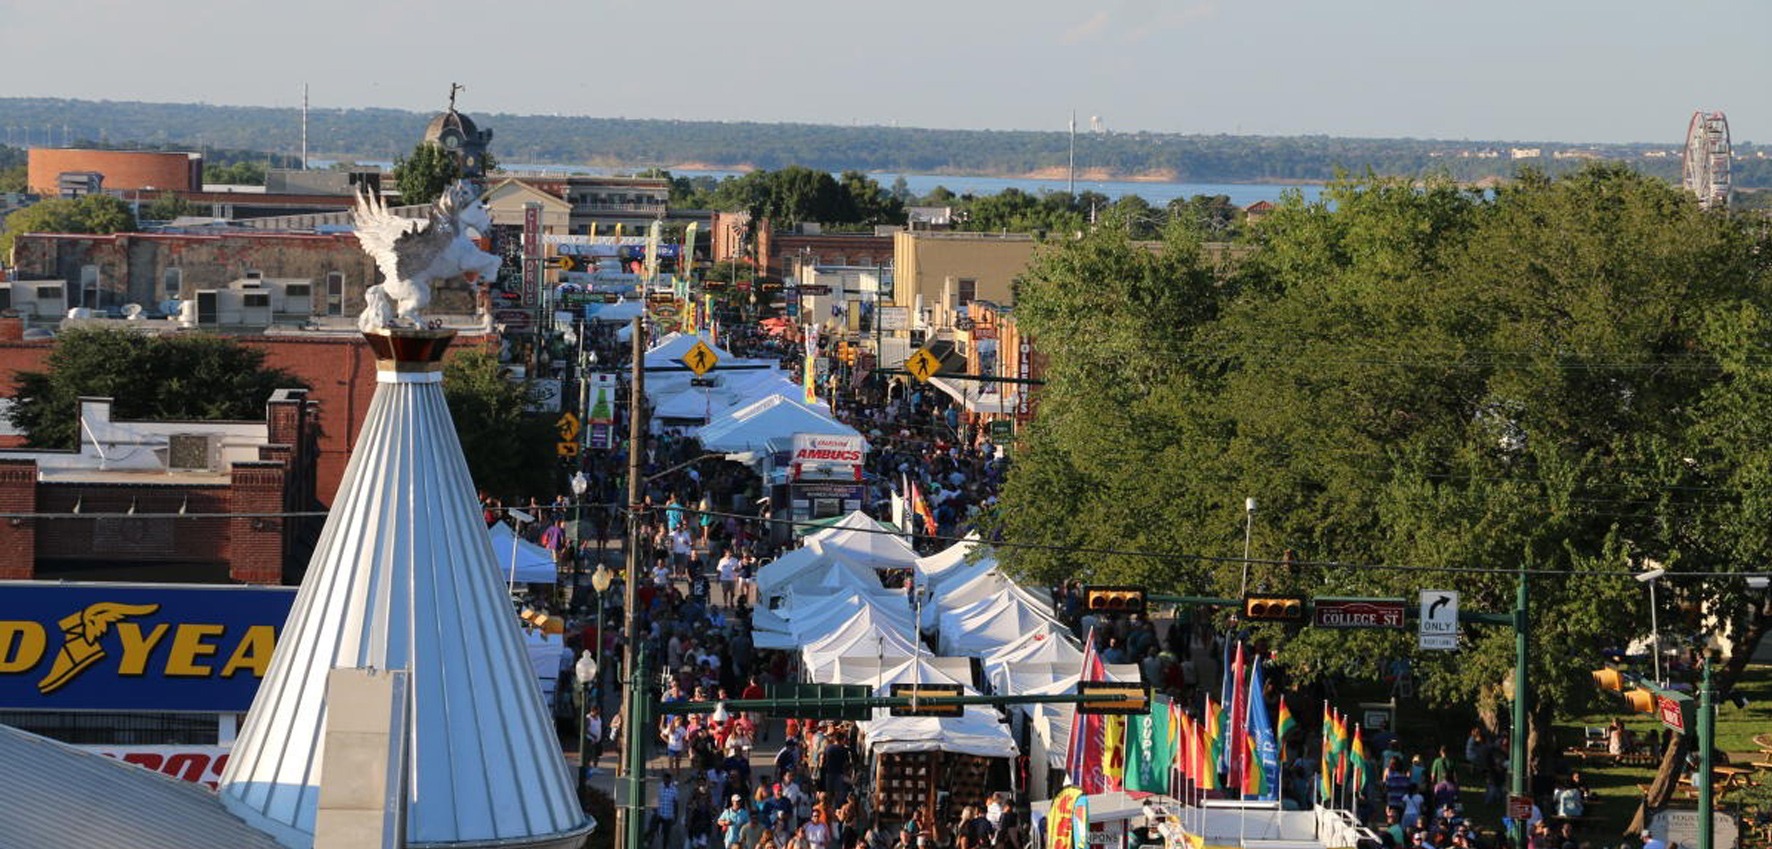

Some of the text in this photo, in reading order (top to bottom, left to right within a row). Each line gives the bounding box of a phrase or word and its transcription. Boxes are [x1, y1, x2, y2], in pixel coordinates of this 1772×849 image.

[525, 210, 535, 305] CITY DRUG
[797, 448, 861, 461] AMBUCS
[1323, 613, 1399, 626] COLLEGE ST
[1424, 621, 1451, 631] ONLY
